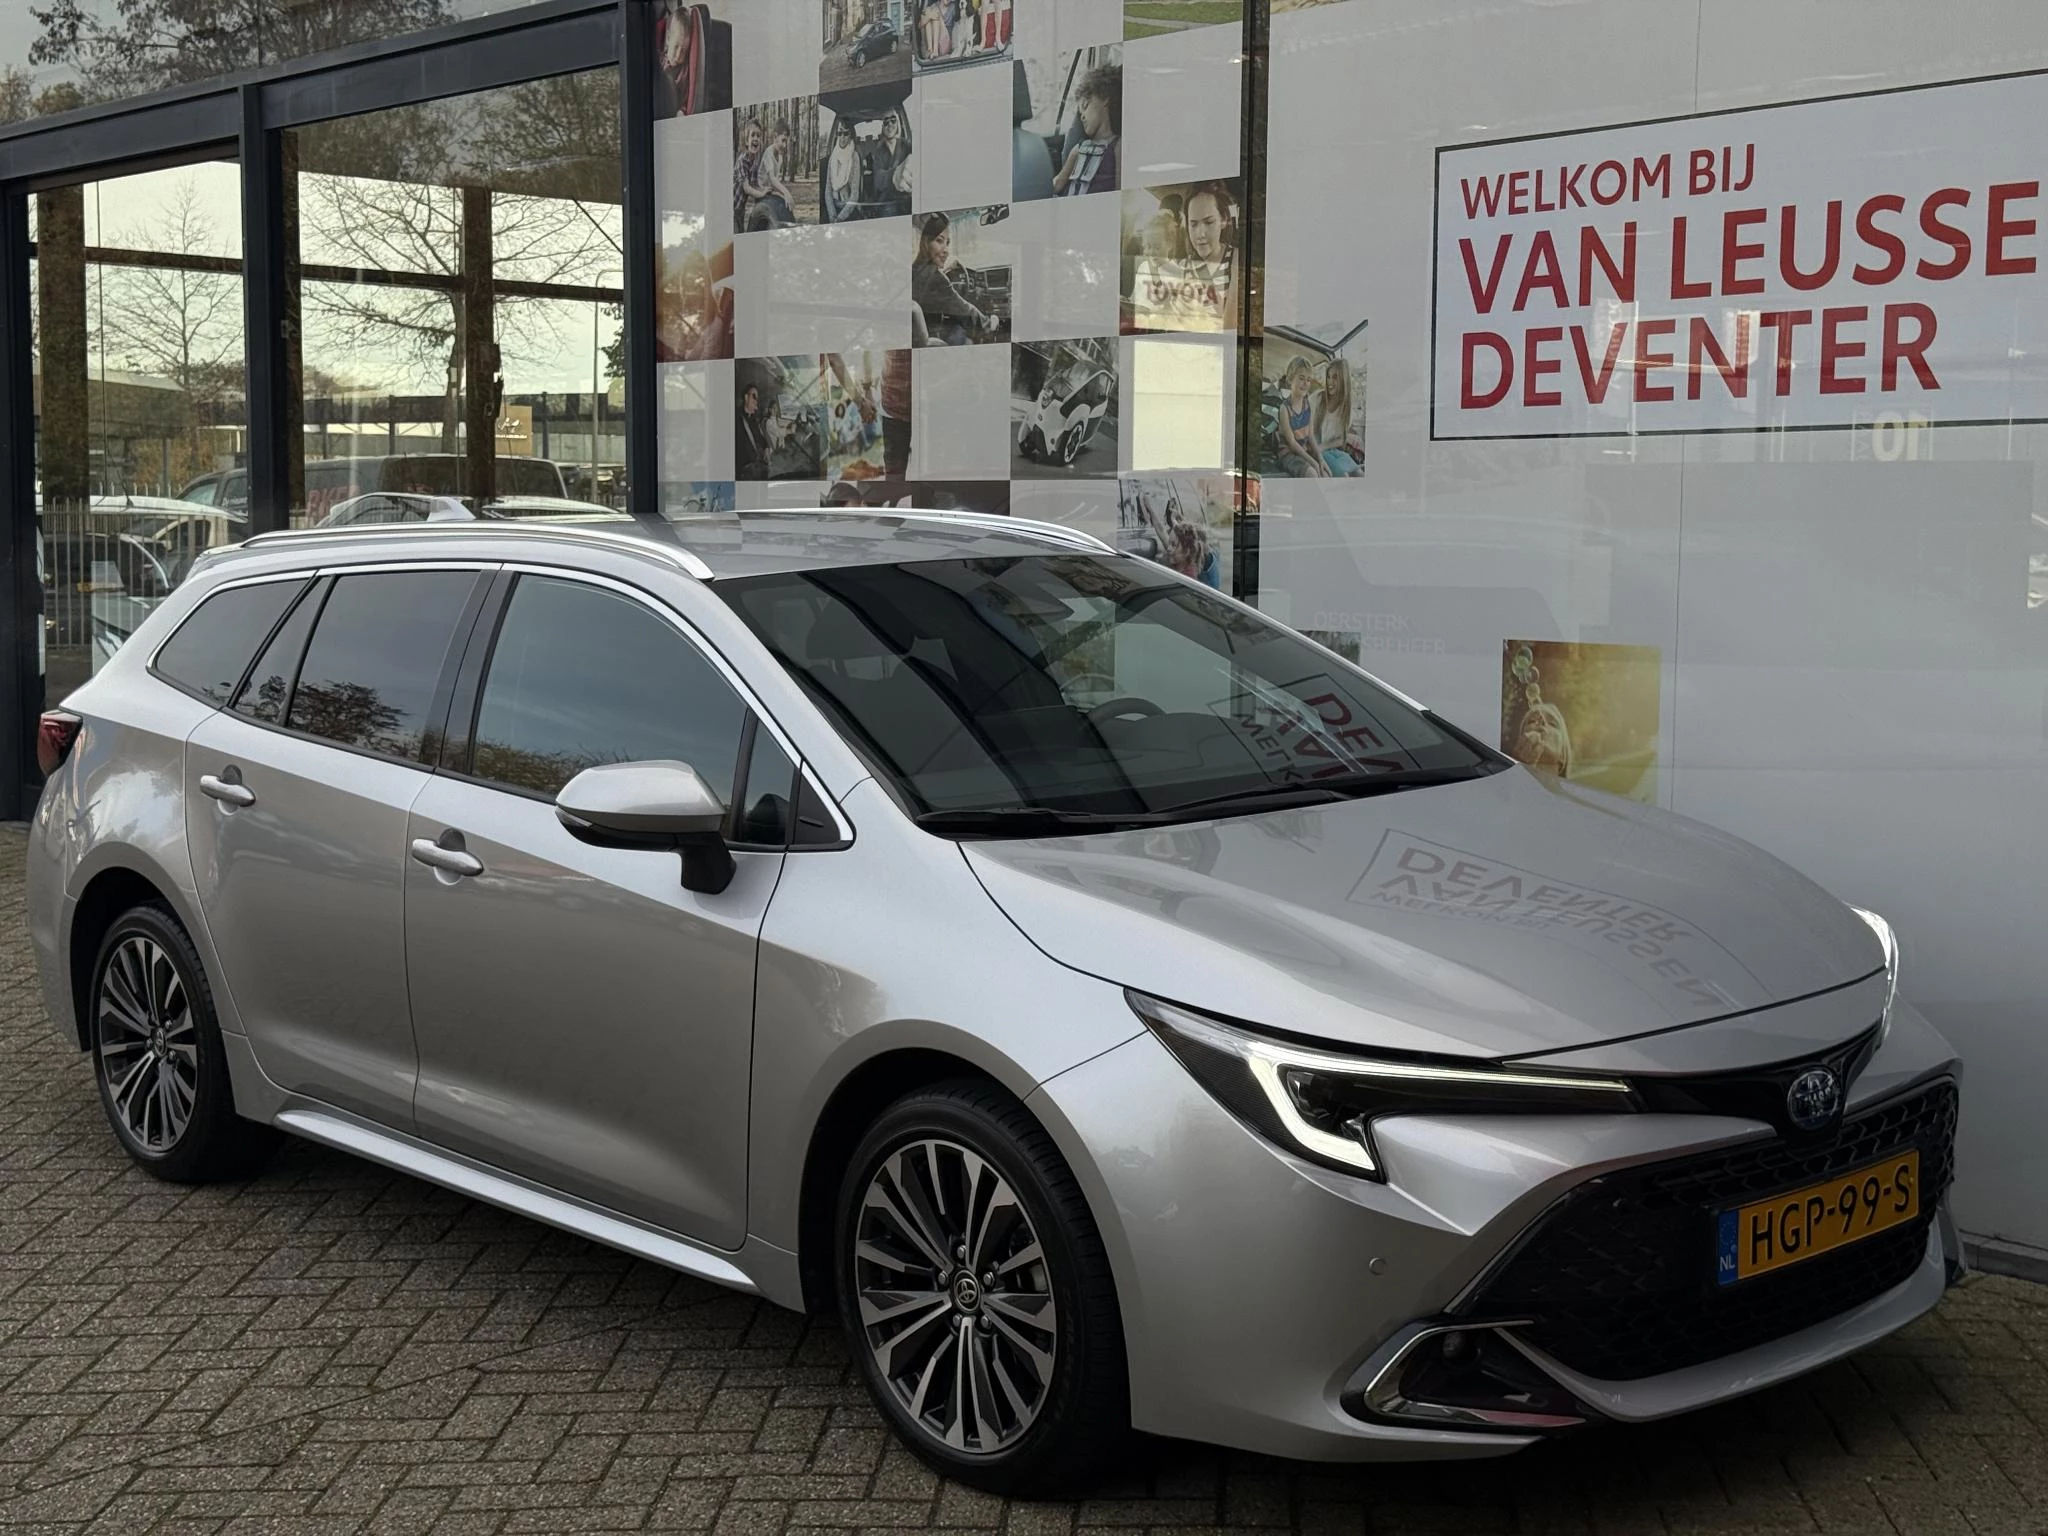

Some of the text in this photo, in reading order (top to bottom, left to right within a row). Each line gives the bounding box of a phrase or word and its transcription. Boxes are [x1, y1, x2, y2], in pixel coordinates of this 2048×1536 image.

[1460, 143, 1756, 220] WELKOM BIJ
[1459, 181, 2040, 314] VAN LEUSSE
[1460, 302, 1942, 411] DEVENTER
[1720, 1253, 1736, 1272] NL
[1751, 1164, 1911, 1265] HGP-99-S
